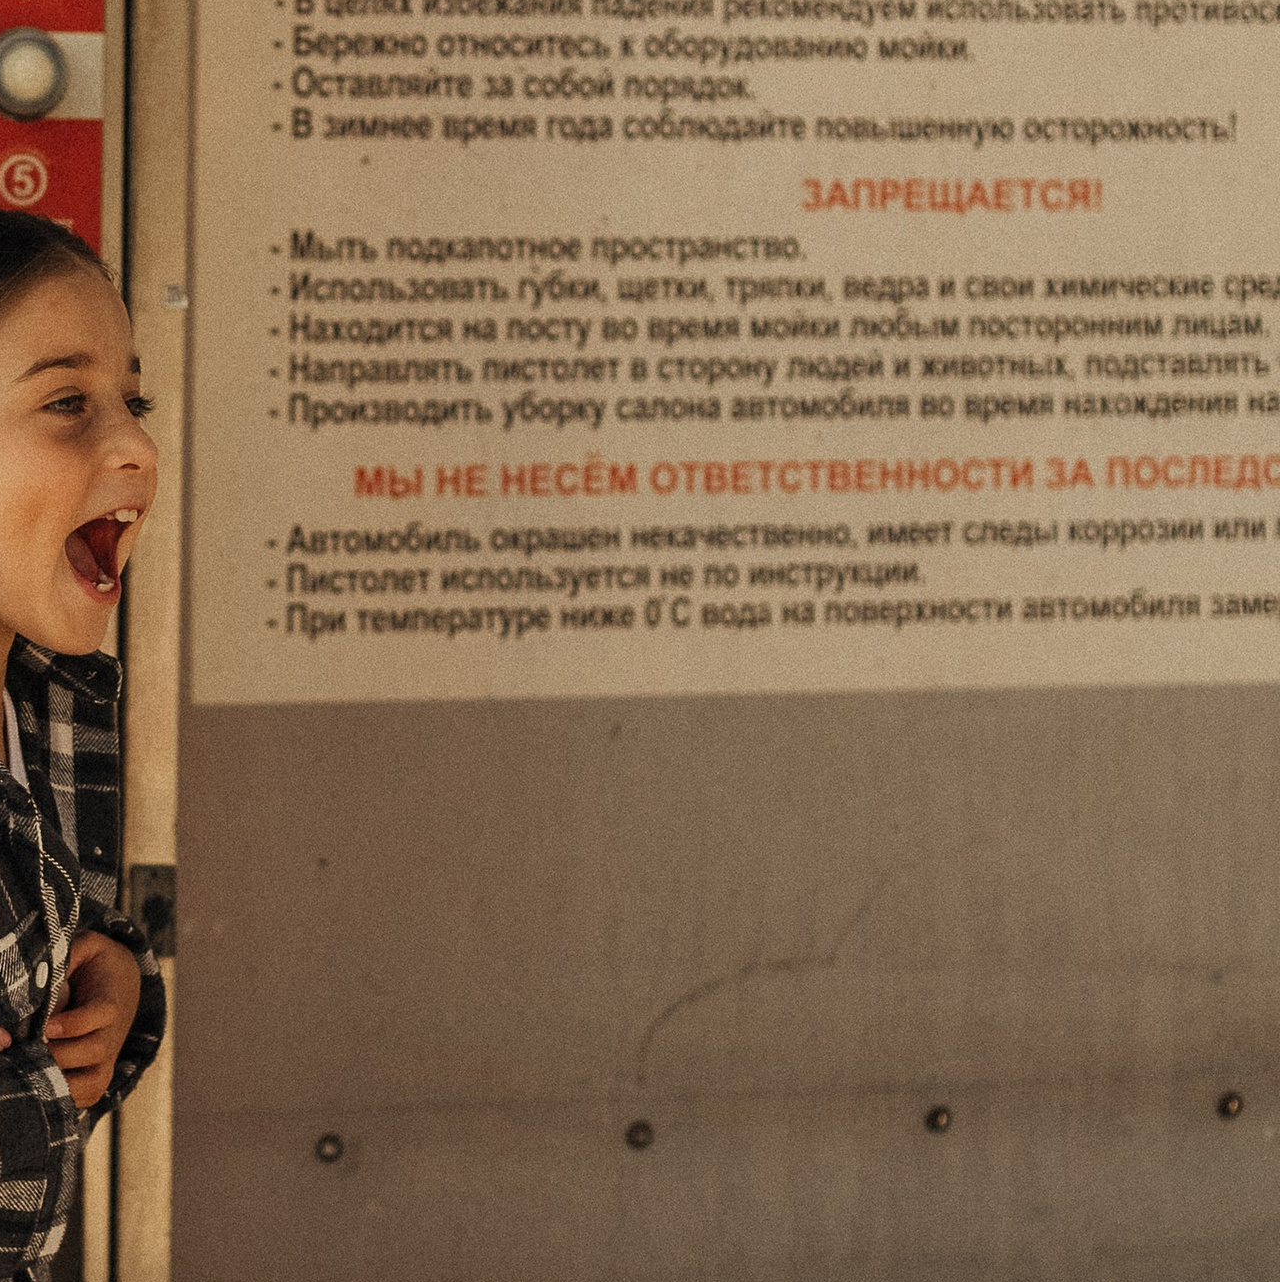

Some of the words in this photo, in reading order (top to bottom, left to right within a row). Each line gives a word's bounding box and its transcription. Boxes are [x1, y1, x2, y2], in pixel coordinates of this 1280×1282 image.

[293, 23, 429, 62] Бережно
[436, 30, 611, 59] относитесь
[621, 32, 636, 58] к
[644, 28, 869, 67] оборудованию
[877, 30, 975, 63] мойки.
[291, 65, 474, 99] Оставляйте
[482, 74, 514, 99] за
[523, 67, 614, 99] собой
[623, 74, 755, 105] порядок.
[291, 107, 313, 140] В
[324, 116, 432, 140] зимнее
[442, 116, 536, 147] время
[546, 116, 614, 143] года
[622, 108, 806, 144] соблюдайте
[815, 117, 1014, 150] повышенную
[1023, 112, 1238, 145] осторожность!
[801, 177, 1105, 214] ЗАПРЕЩАЕТСЯ!
[289, 228, 379, 262] Мыть
[386, 236, 583, 265] подкапотное
[591, 235, 807, 266] пространство.
[289, 271, 510, 303] Использовать
[518, 269, 608, 309] губки,
[616, 277, 714, 305] щетки,
[724, 275, 833, 307] тряпки,
[842, 277, 930, 305] ведра
[938, 277, 957, 300] и
[964, 276, 1034, 300] свои
[1044, 275, 1214, 300] химические
[289, 312, 453, 344] Находится
[461, 319, 498, 342] на
[506, 317, 590, 349] посту
[601, 318, 638, 341] во
[647, 317, 740, 347] время
[750, 311, 840, 339] мойки
[850, 307, 960, 339] любым
[968, 315, 1163, 343] посторонним
[288, 352, 473, 389] Направлять
[482, 358, 618, 383] пистолет
[630, 359, 647, 381] в
[657, 355, 778, 386] сторону
[785, 350, 884, 381] людей
[893, 355, 911, 377] и
[920, 354, 1074, 382] животных,
[1084, 353, 1270, 379] подставлять
[288, 392, 492, 431] Производить
[501, 389, 606, 430] уборку
[615, 396, 720, 418] салона
[730, 387, 910, 417] автомобиля
[920, 394, 955, 417] во
[963, 393, 1055, 424] время
[1062, 392, 1238, 419] нахождения
[354, 463, 423, 500] МЫ
[436, 463, 489, 497] НЕ
[500, 450, 637, 497] НЕСЁМ
[649, 456, 1034, 495] ОТВЕТСТВЕННОСТИ
[1044, 456, 1095, 490] ЗА
[287, 521, 480, 556] Автомобиль
[489, 526, 621, 558] окрашен
[630, 523, 858, 550] некачественно,
[867, 522, 952, 545] имеет
[962, 520, 1058, 548] следы
[1068, 518, 1203, 550] коррозии
[1213, 519, 1266, 541] или
[287, 562, 429, 595] Пистолет
[441, 565, 651, 598] используется
[660, 565, 694, 590] не
[703, 564, 739, 590] по
[748, 561, 926, 593] инструкции.
[287, 603, 347, 642] При
[357, 607, 550, 640] температуре
[560, 606, 634, 629] ниже
[702, 602, 772, 628] вода
[782, 602, 814, 624] на
[824, 597, 1011, 629] поверхности
[1023, 587, 1199, 618] автомобиля
